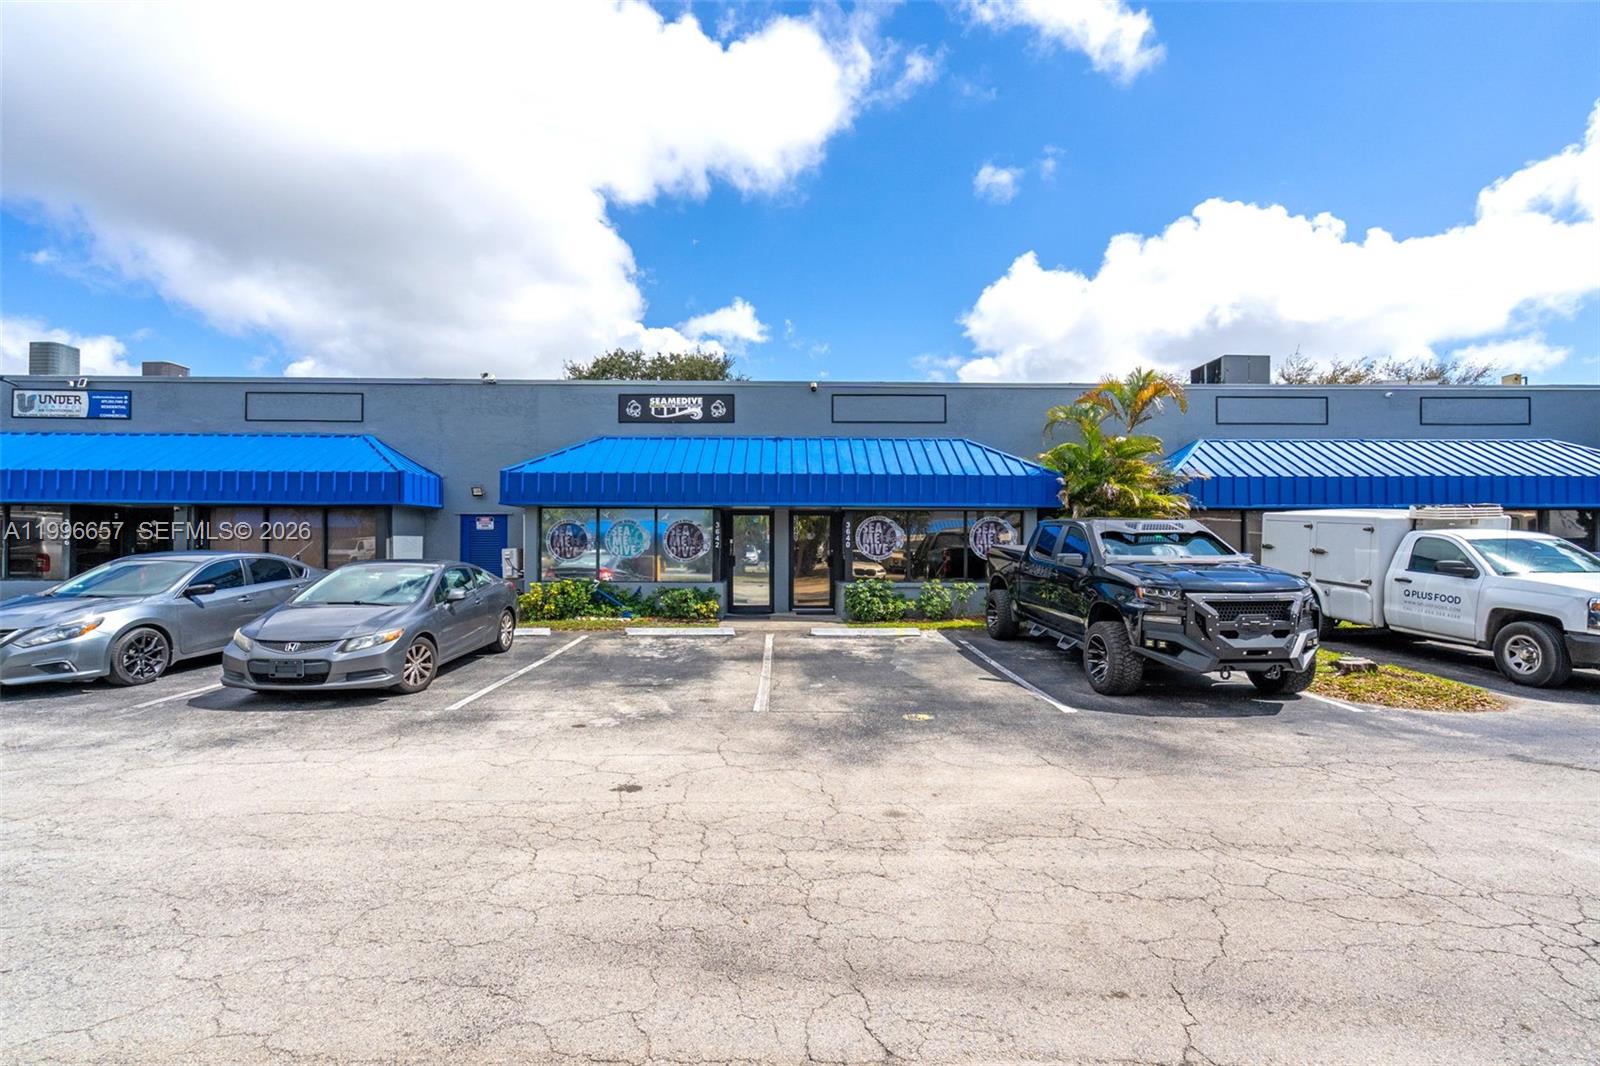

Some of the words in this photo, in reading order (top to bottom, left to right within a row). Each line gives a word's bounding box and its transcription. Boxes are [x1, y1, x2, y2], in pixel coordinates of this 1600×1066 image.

[39, 394, 82, 405] UNDER
[649, 397, 703, 405] SEAMEDIVE
[863, 522, 883, 533] SEA
[862, 532, 881, 544] ME
[863, 543, 890, 555] DIVE
[1412, 590, 1433, 600] PLUS
[1434, 593, 1462, 604] FOOD
